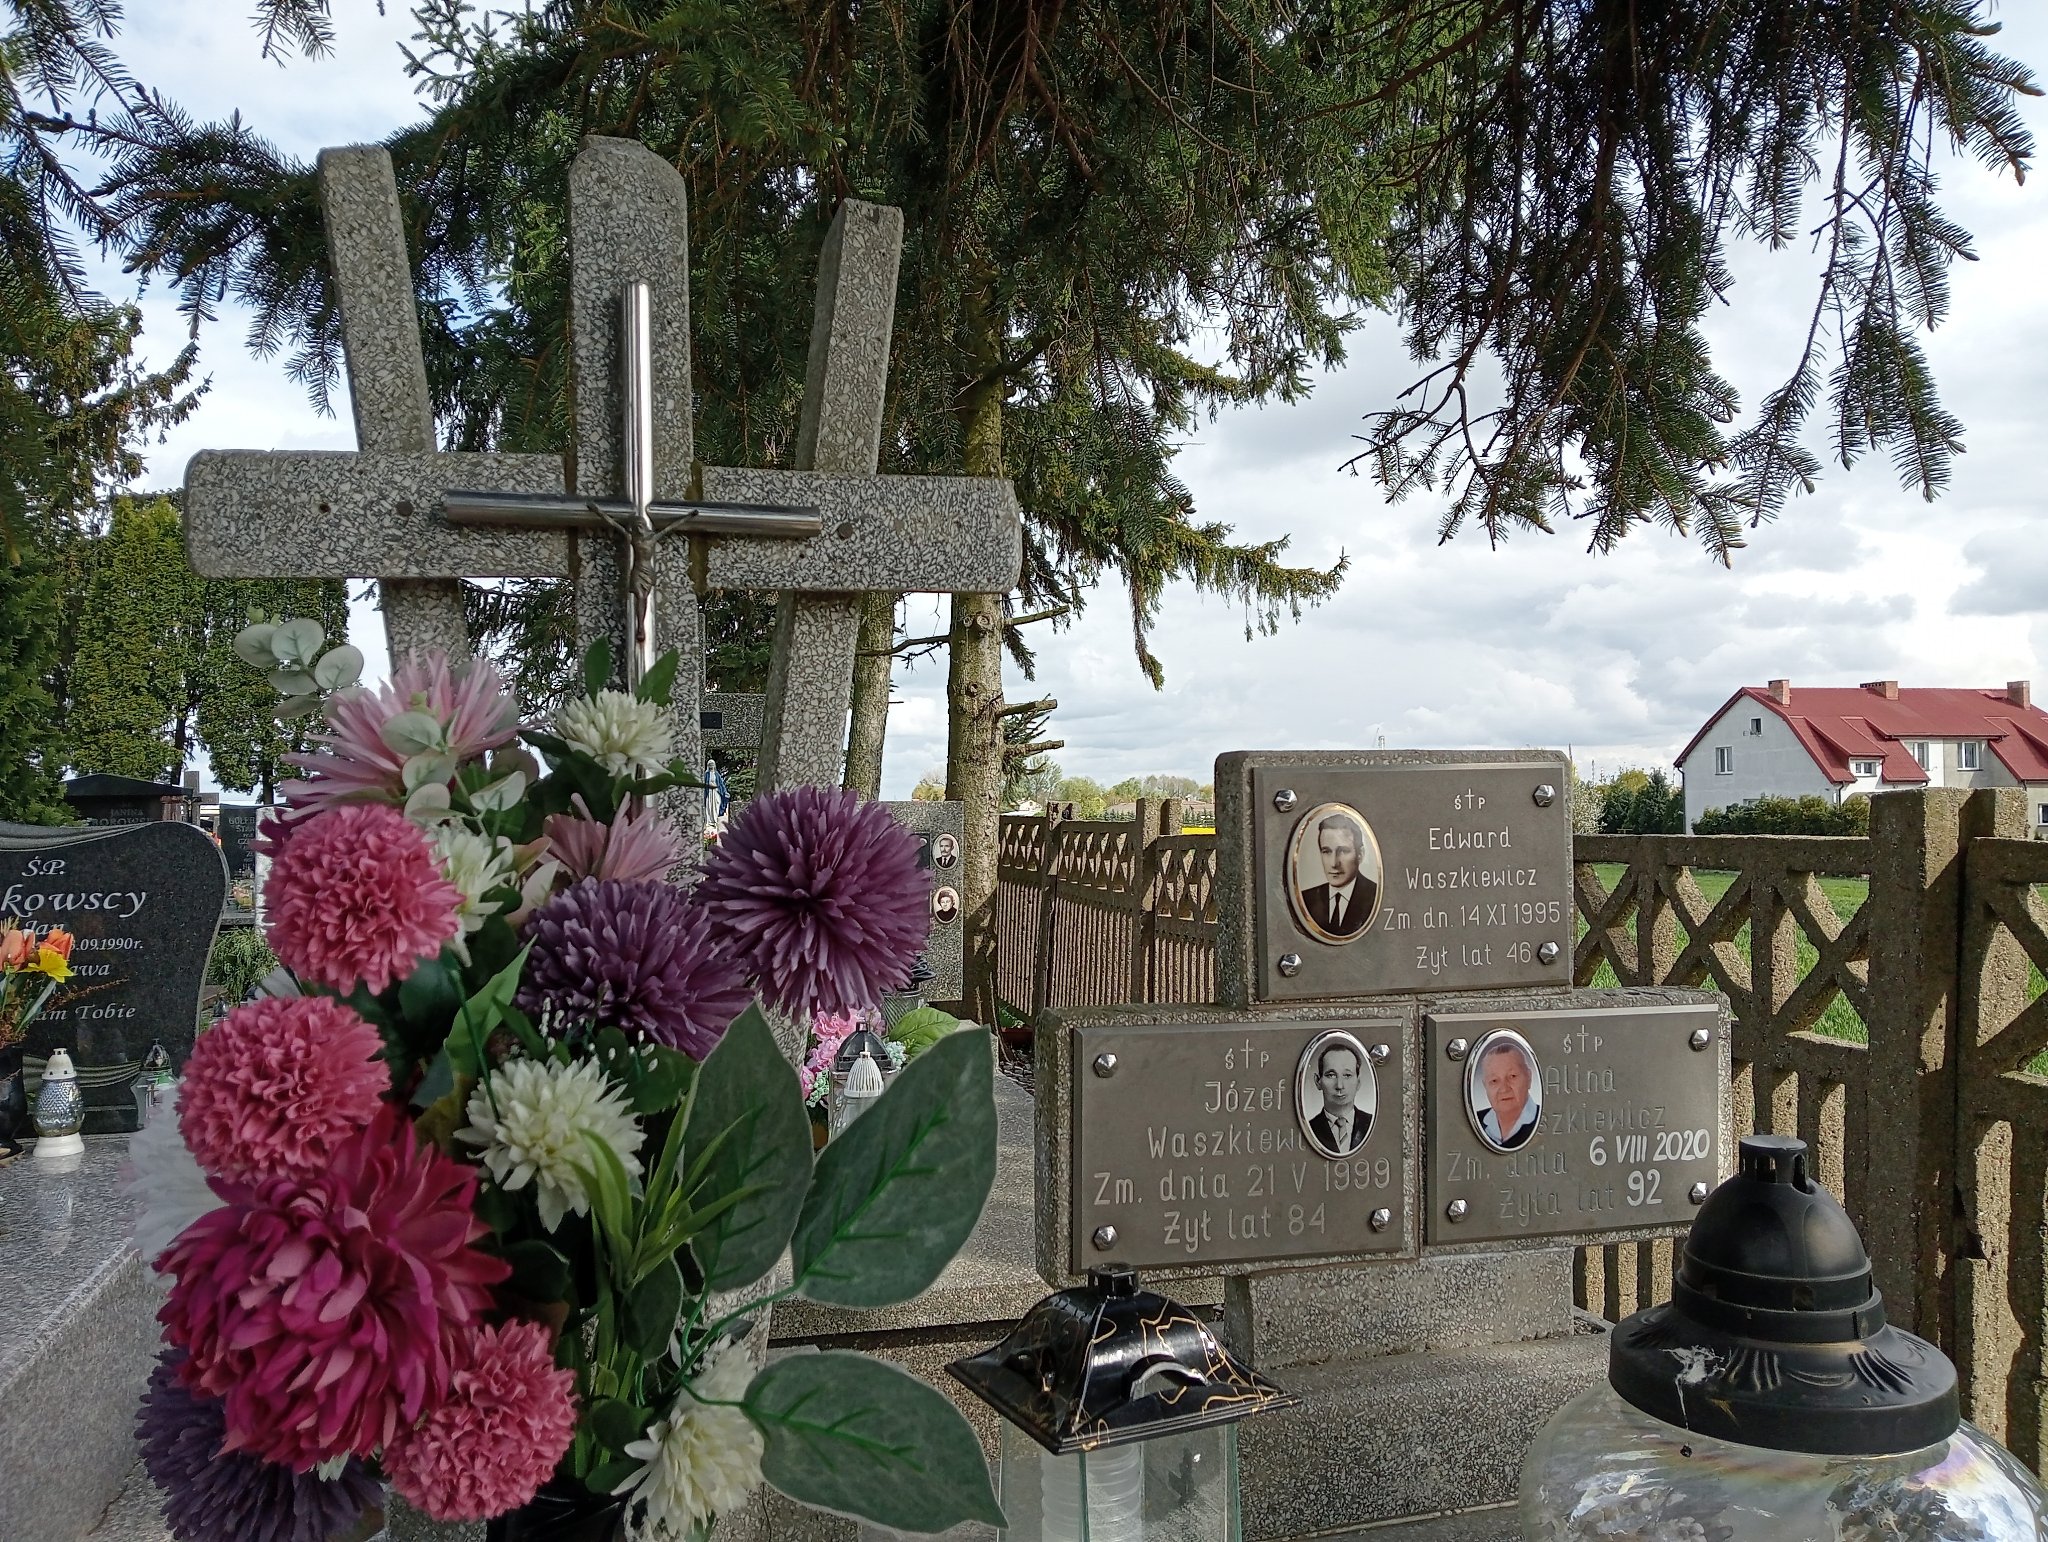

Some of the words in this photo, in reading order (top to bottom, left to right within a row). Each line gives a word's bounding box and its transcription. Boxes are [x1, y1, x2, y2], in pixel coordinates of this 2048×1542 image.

[1429, 826, 1511, 850] Edward
[21, 855, 66, 877] Ś.P.
[1405, 864, 1537, 889] Waszkiewicz
[1383, 908, 1416, 931] Zm.
[1424, 906, 1453, 929] dn.
[1460, 904, 1480, 926] 14
[1486, 903, 1507, 925] XI
[1514, 901, 1561, 924] 1995
[69, 963, 111, 976] awa
[1462, 944, 1492, 966] lat
[1507, 942, 1531, 963] 46
[75, 1003, 136, 1020] Tobie
[1545, 1064, 1617, 1095] Alina
[1204, 1079, 1286, 1113] Józef
[1536, 1100, 1666, 1135] szkiewicz
[1148, 1122, 1307, 1159] Waszkiewi
[1447, 1152, 1490, 1181] Zm.
[1505, 1145, 1567, 1178] dnia
[1589, 1135, 1607, 1166] 6
[1616, 1134, 1647, 1164] VIII
[1652, 1128, 1711, 1161] 2020
[1094, 1172, 1142, 1205] Zm.
[1159, 1166, 1230, 1202] dnia
[1247, 1164, 1275, 1197] 21
[1291, 1161, 1307, 1193] V
[1323, 1157, 1390, 1192] 1999
[1577, 1181, 1615, 1212] lat
[1626, 1168, 1662, 1206] 92
[1228, 1206, 1271, 1240] lat
[1288, 1202, 1326, 1236] 84
